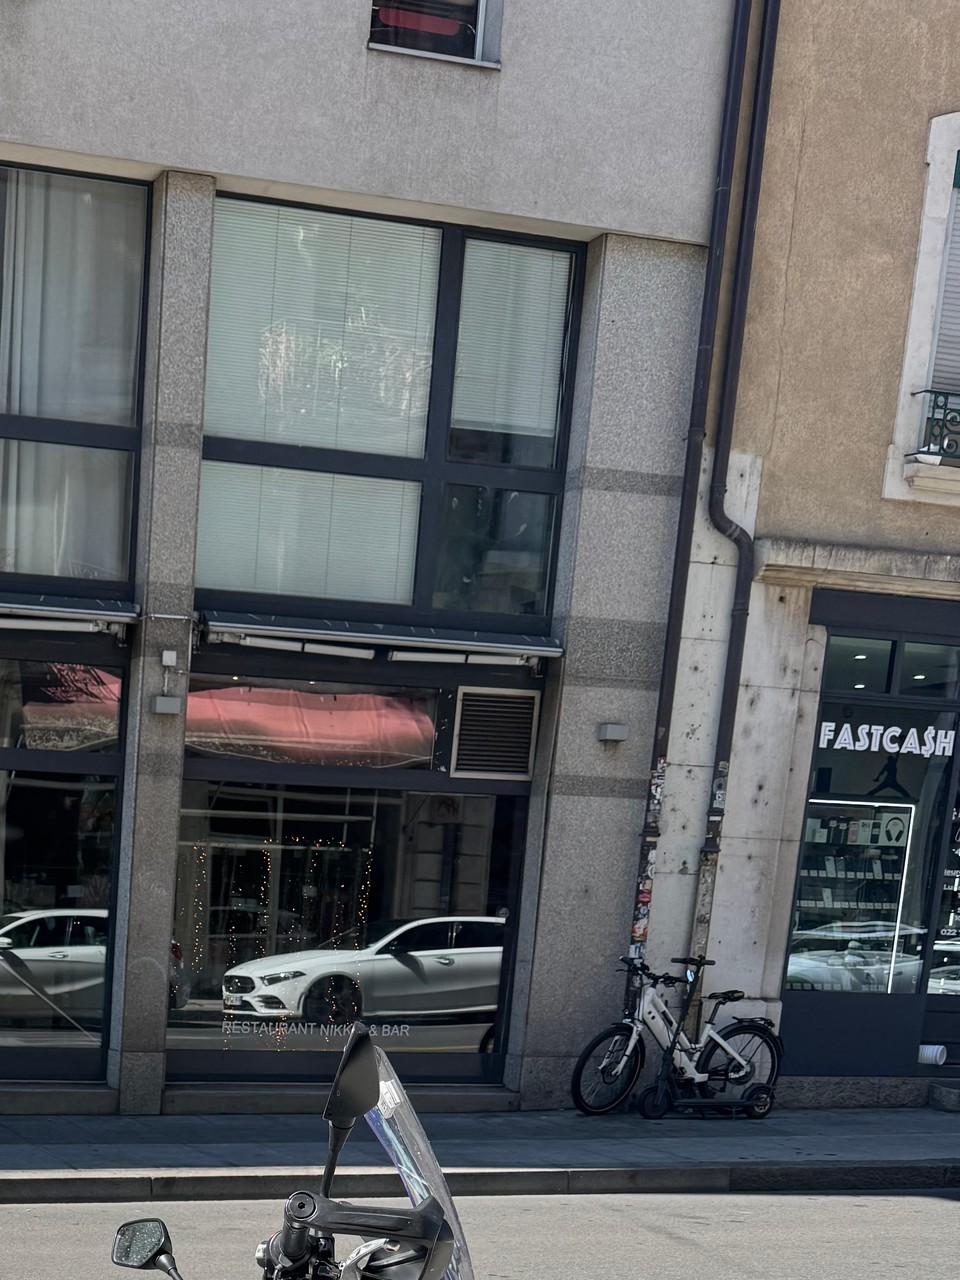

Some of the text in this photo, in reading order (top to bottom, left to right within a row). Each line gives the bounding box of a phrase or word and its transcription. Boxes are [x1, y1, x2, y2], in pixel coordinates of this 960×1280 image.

[221, 1021, 316, 1034] RESTAURANT
[369, 1024, 378, 1036] &
[381, 1024, 410, 1037] BAR
